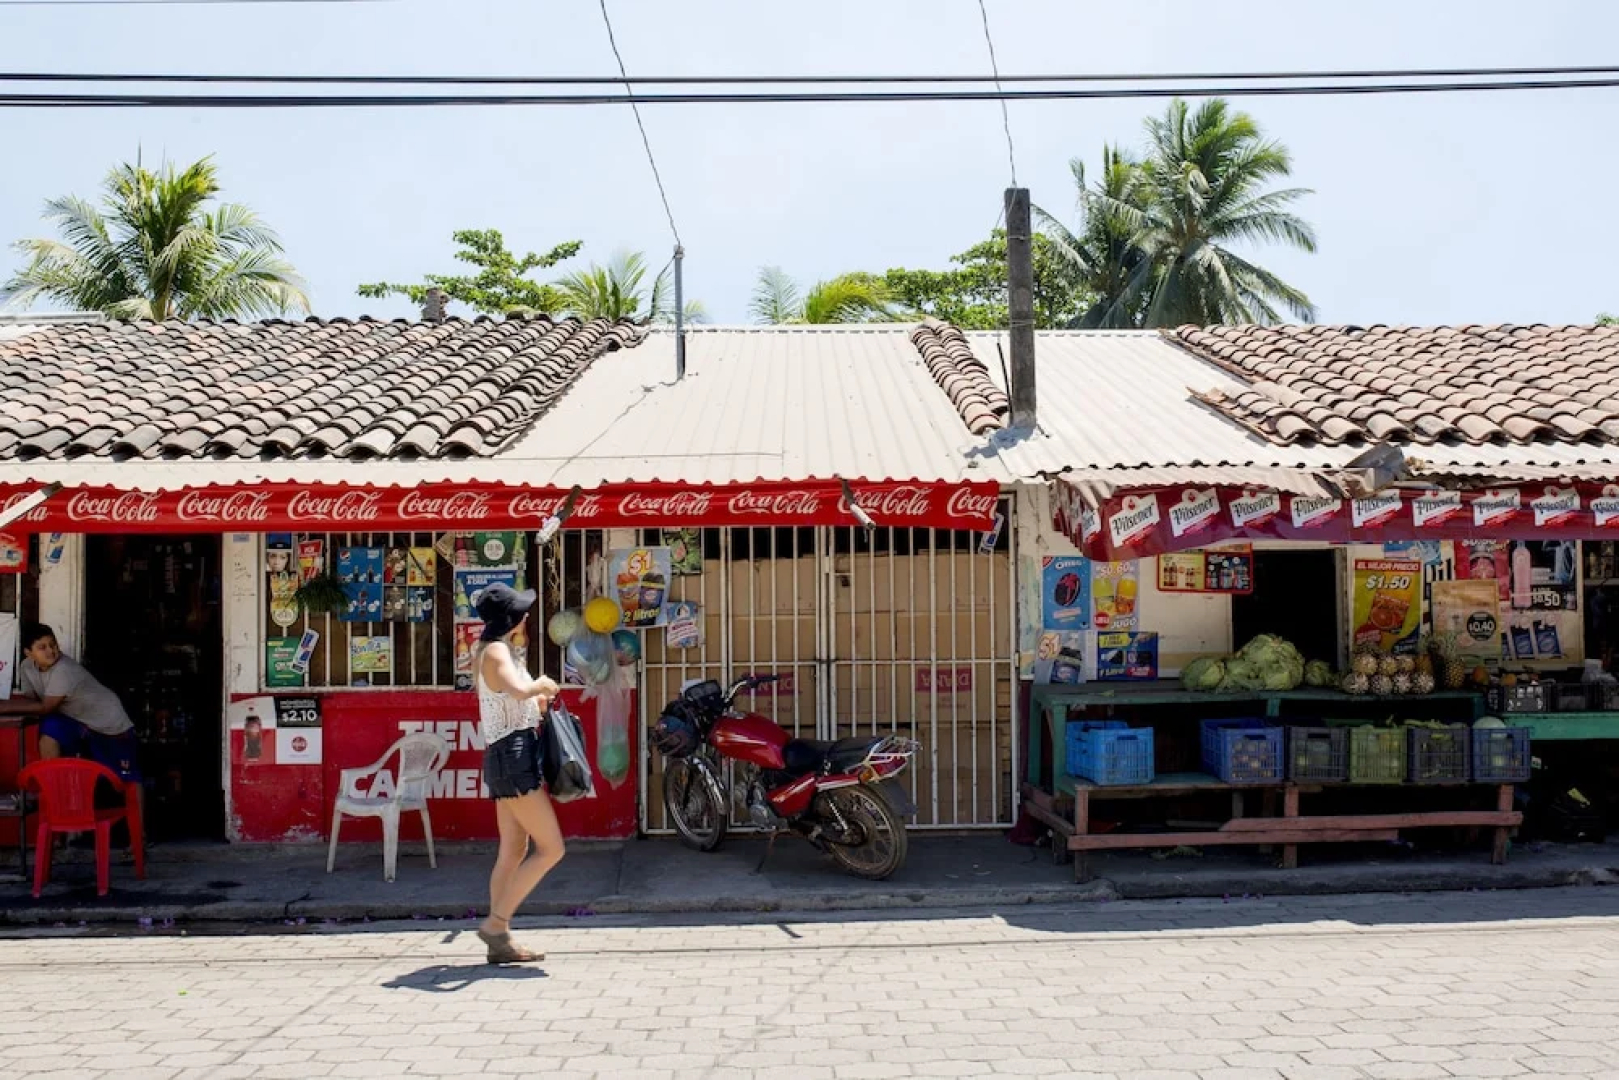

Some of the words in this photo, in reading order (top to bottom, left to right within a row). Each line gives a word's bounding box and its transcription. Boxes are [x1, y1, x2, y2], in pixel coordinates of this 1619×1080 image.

[508, 492, 602, 518] Coca-Cla
[1171, 496, 1214, 525] Pilsener
[1232, 495, 1274, 517] Pilsener
[1112, 505, 1153, 536] Pilsener
[1392, 561, 1419, 570] PRECIO
[1366, 574, 1410, 589] $1.50
[282, 710, 318, 723] $2.10
[398, 720, 489, 751] TIEN
